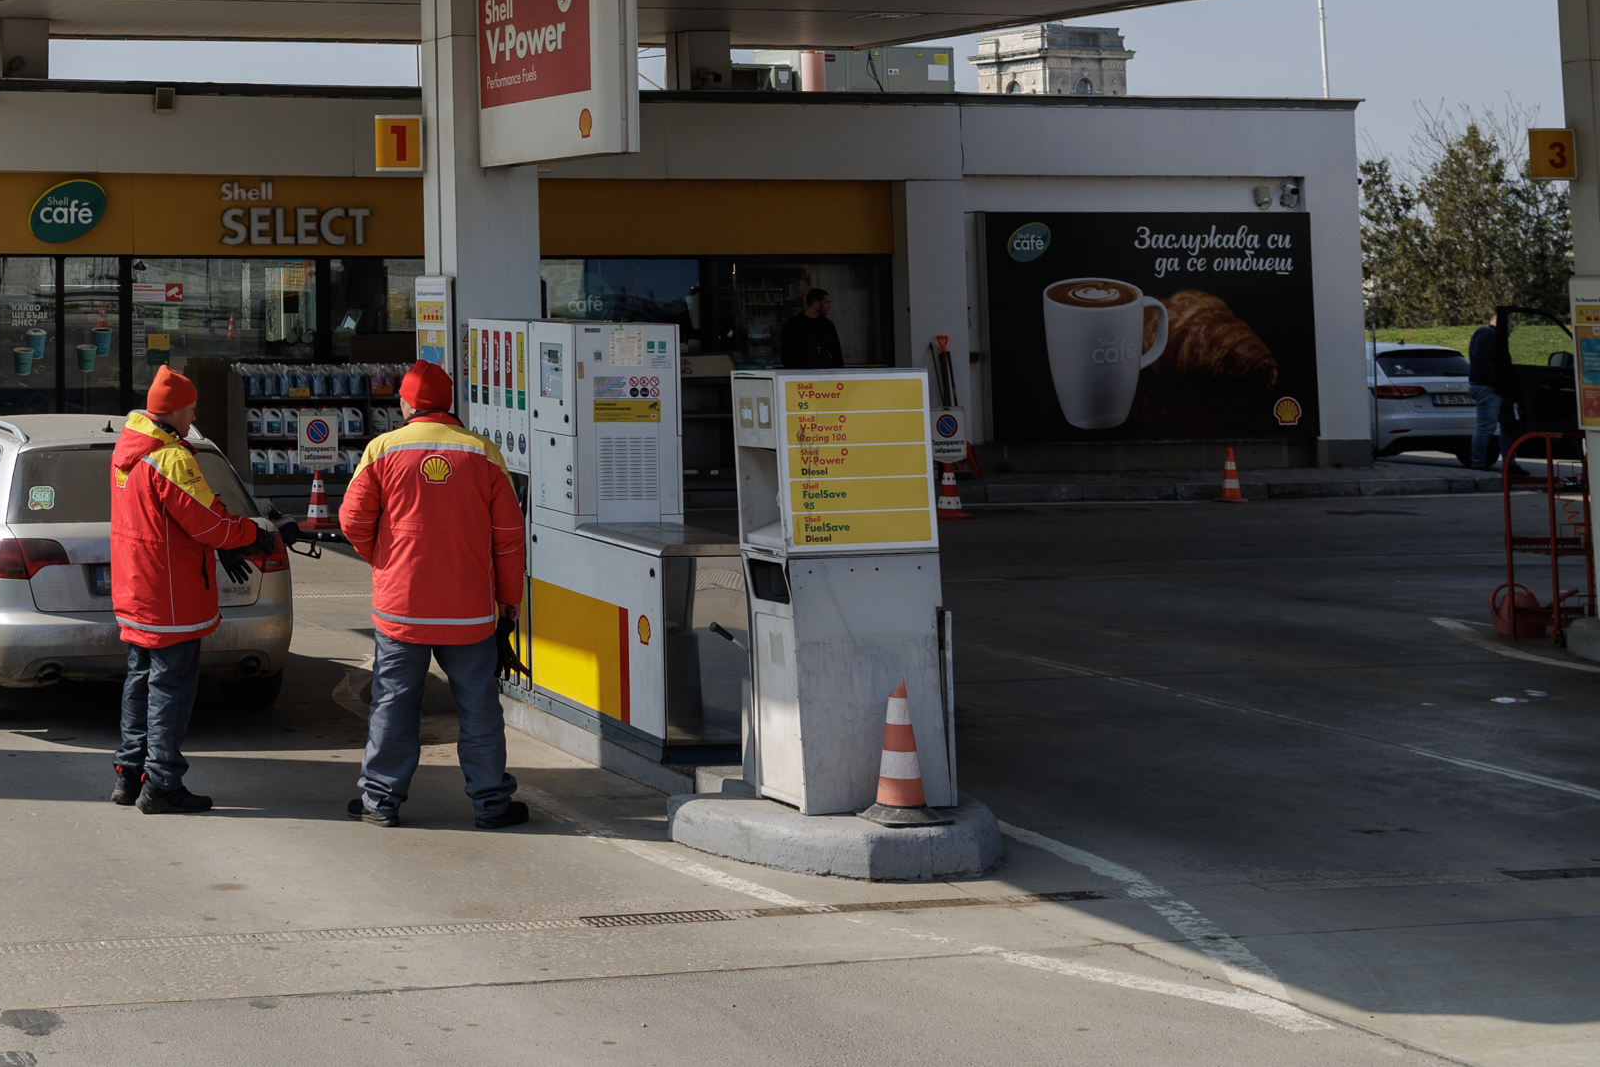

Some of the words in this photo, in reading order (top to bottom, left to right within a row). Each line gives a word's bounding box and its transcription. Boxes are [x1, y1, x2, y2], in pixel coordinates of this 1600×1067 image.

[485, 21, 566, 65] V-Power
[486, 72, 521, 90] Performance
[522, 64, 537, 82] Fuels
[391, 125, 406, 161] 1
[1548, 142, 1566, 168] 3
[220, 181, 273, 201] Shell
[47, 196, 69, 207] Shell
[39, 199, 93, 225] café
[221, 207, 370, 246] SELECT
[1013, 235, 1044, 251] café
[1134, 224, 1260, 256] Заслужава
[1267, 234, 1292, 249] си
[1154, 257, 1180, 278] да
[1186, 257, 1207, 271] се
[1213, 250, 1294, 274] отбиеш
[568, 294, 604, 312] café
[11, 319, 38, 327] ДНЕС?
[1098, 338, 1119, 347] Shell
[1091, 337, 1136, 365] café
[798, 391, 841, 399] V-Power
[798, 402, 809, 410] 95
[799, 423, 843, 432] V-Power
[800, 434, 829, 443] Racing
[832, 433, 847, 441] 100
[300, 446, 336, 454] Паркирането
[304, 453, 333, 461] забранено
[801, 456, 845, 465] V-Power
[803, 490, 847, 499] FuelSave
[804, 502, 815, 510] 95
[805, 523, 850, 532] FuelSave
[805, 534, 832, 542] Diesel
